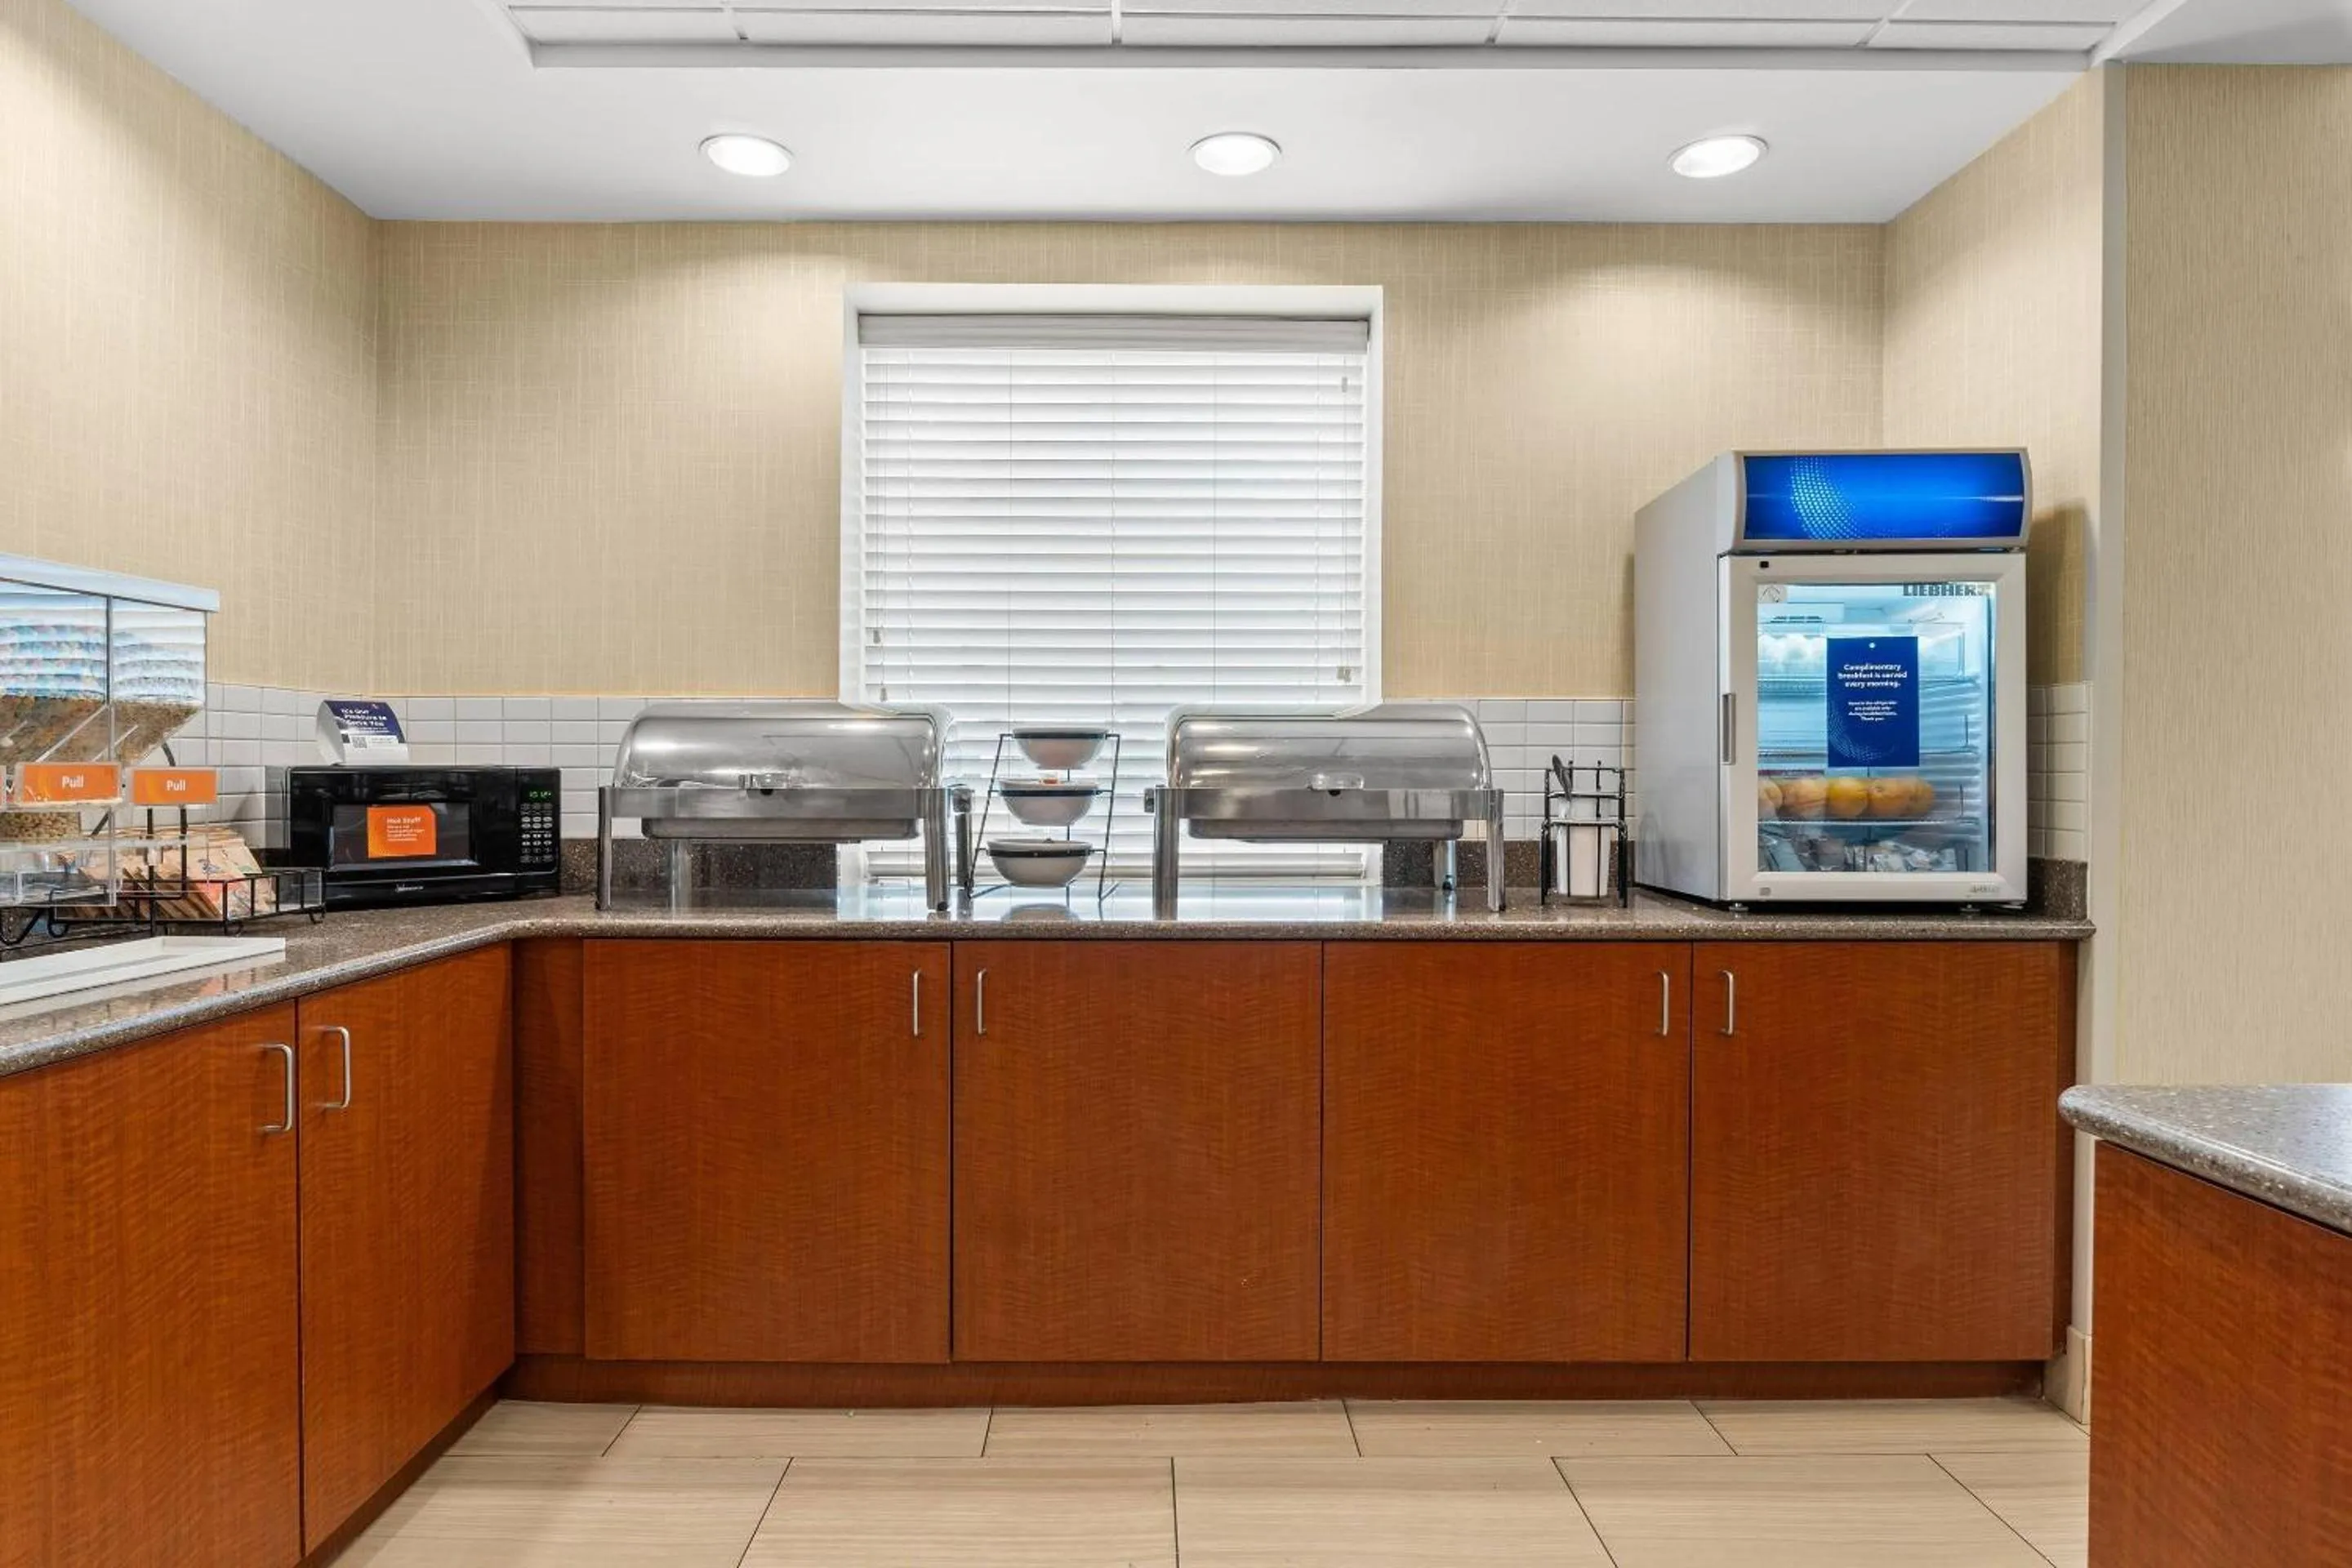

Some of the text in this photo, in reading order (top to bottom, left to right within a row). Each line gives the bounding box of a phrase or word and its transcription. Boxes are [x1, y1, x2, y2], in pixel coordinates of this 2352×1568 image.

[1843, 663, 1902, 671] Complimentary
[1838, 671, 1873, 679] breakfast
[1882, 670, 1908, 679] served
[1845, 679, 1901, 688] every morning.
[61, 775, 85, 789] Pull
[166, 779, 187, 792] Pull
